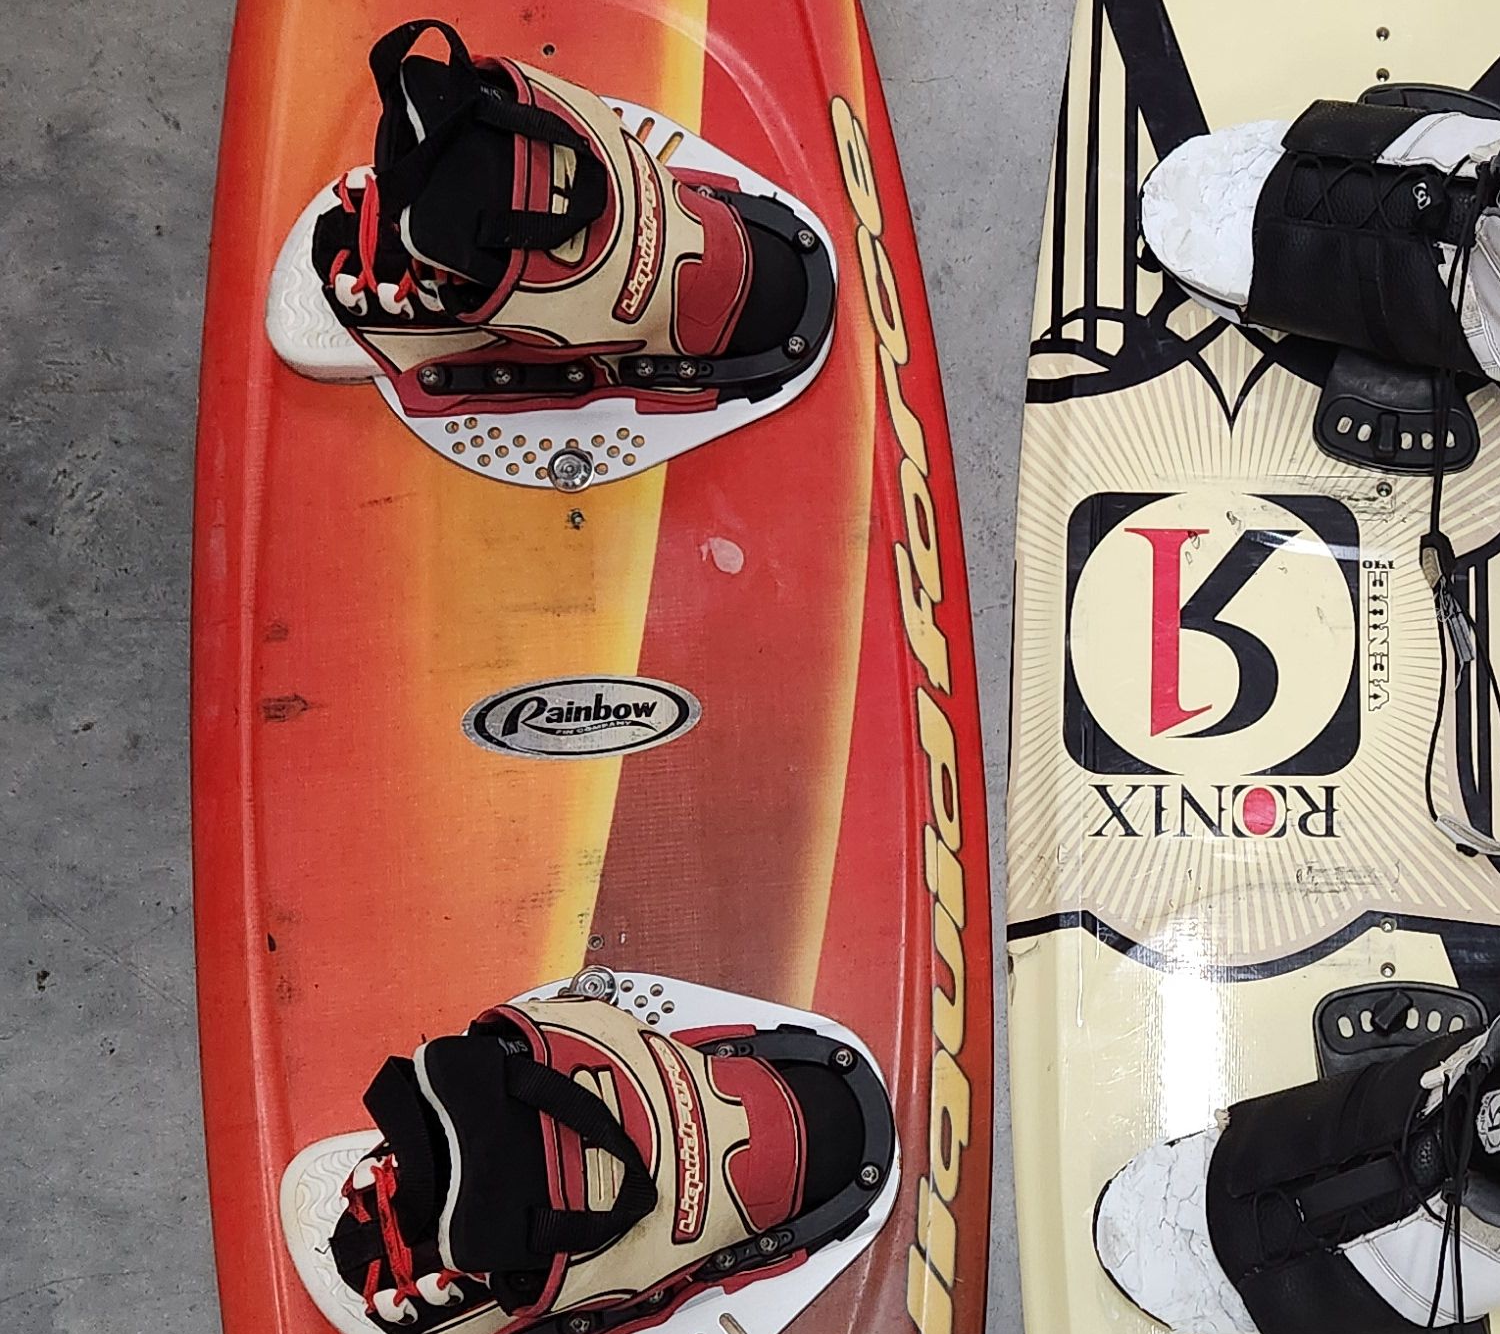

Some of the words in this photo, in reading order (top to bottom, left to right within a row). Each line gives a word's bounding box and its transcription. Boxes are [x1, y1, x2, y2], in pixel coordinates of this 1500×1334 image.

[1366, 570, 1390, 712] VENUE
[501, 693, 659, 737] Rainbow
[576, 720, 632, 733] COMPANY
[1088, 783, 1341, 838] RONIX
